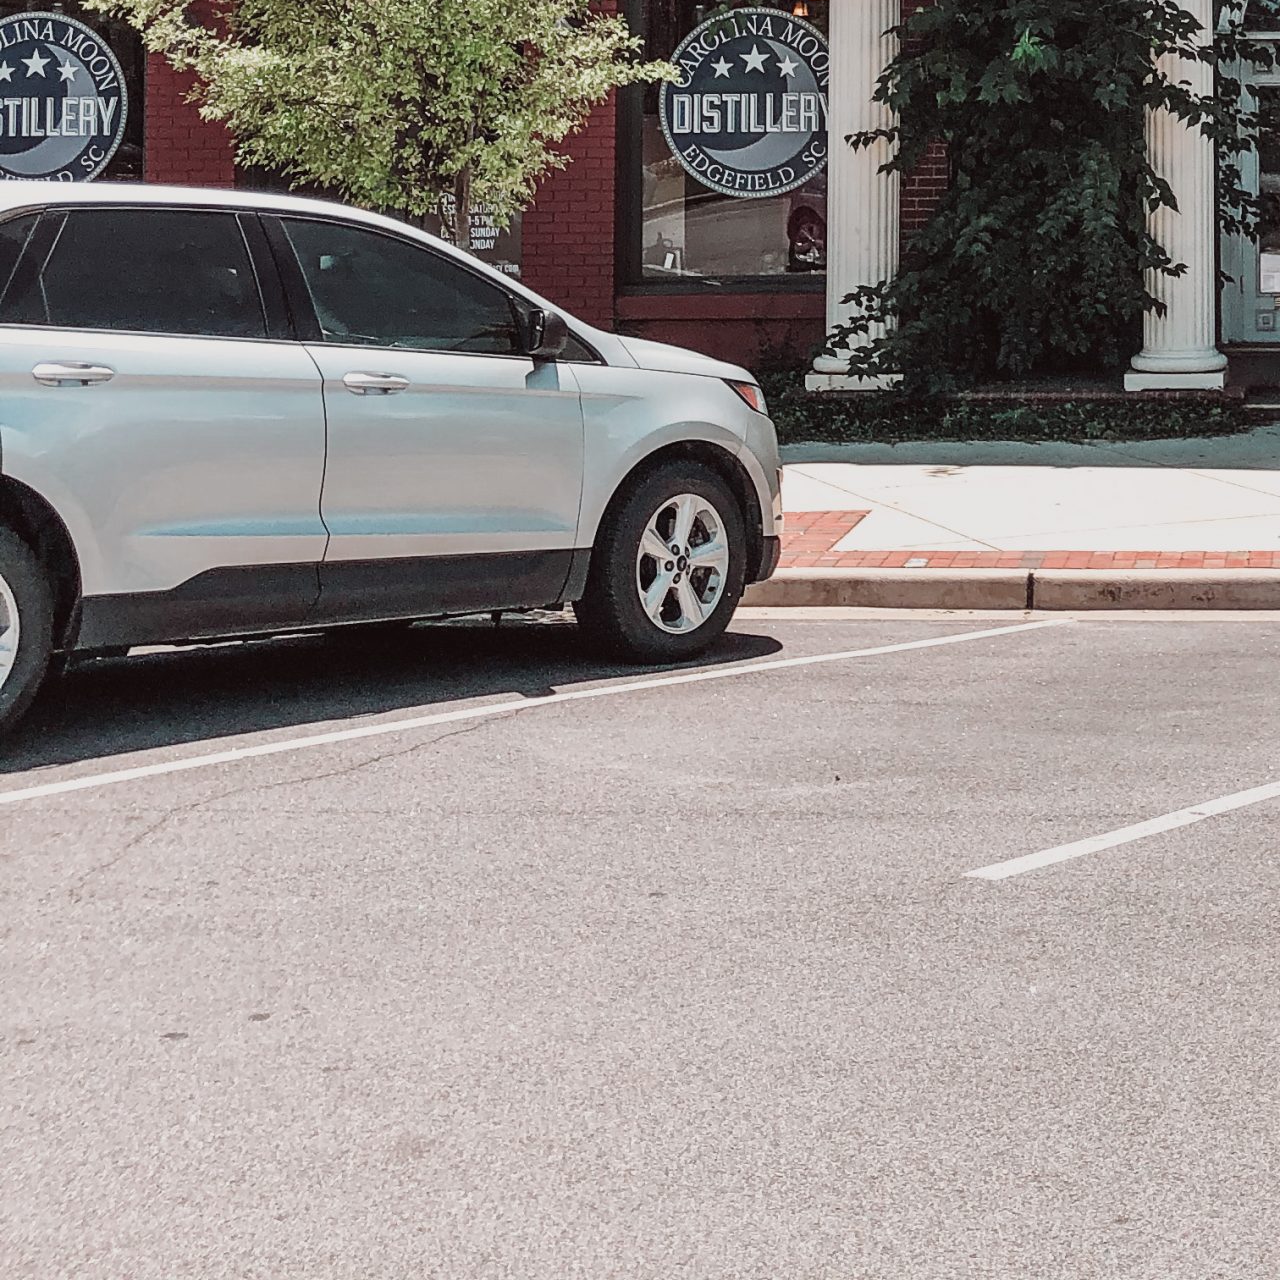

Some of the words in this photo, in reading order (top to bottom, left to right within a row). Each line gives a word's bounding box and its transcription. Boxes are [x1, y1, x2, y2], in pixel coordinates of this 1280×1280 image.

[0, 20, 55, 52] LINA
[60, 26, 118, 91] MOON
[672, 15, 774, 88] CAROLINA
[0, 96, 118, 137] TILLERY
[81, 145, 105, 172] SC
[682, 143, 795, 190] EDGEFIELD
[802, 140, 826, 168] SC
[470, 227, 500, 238] SUNDAY
